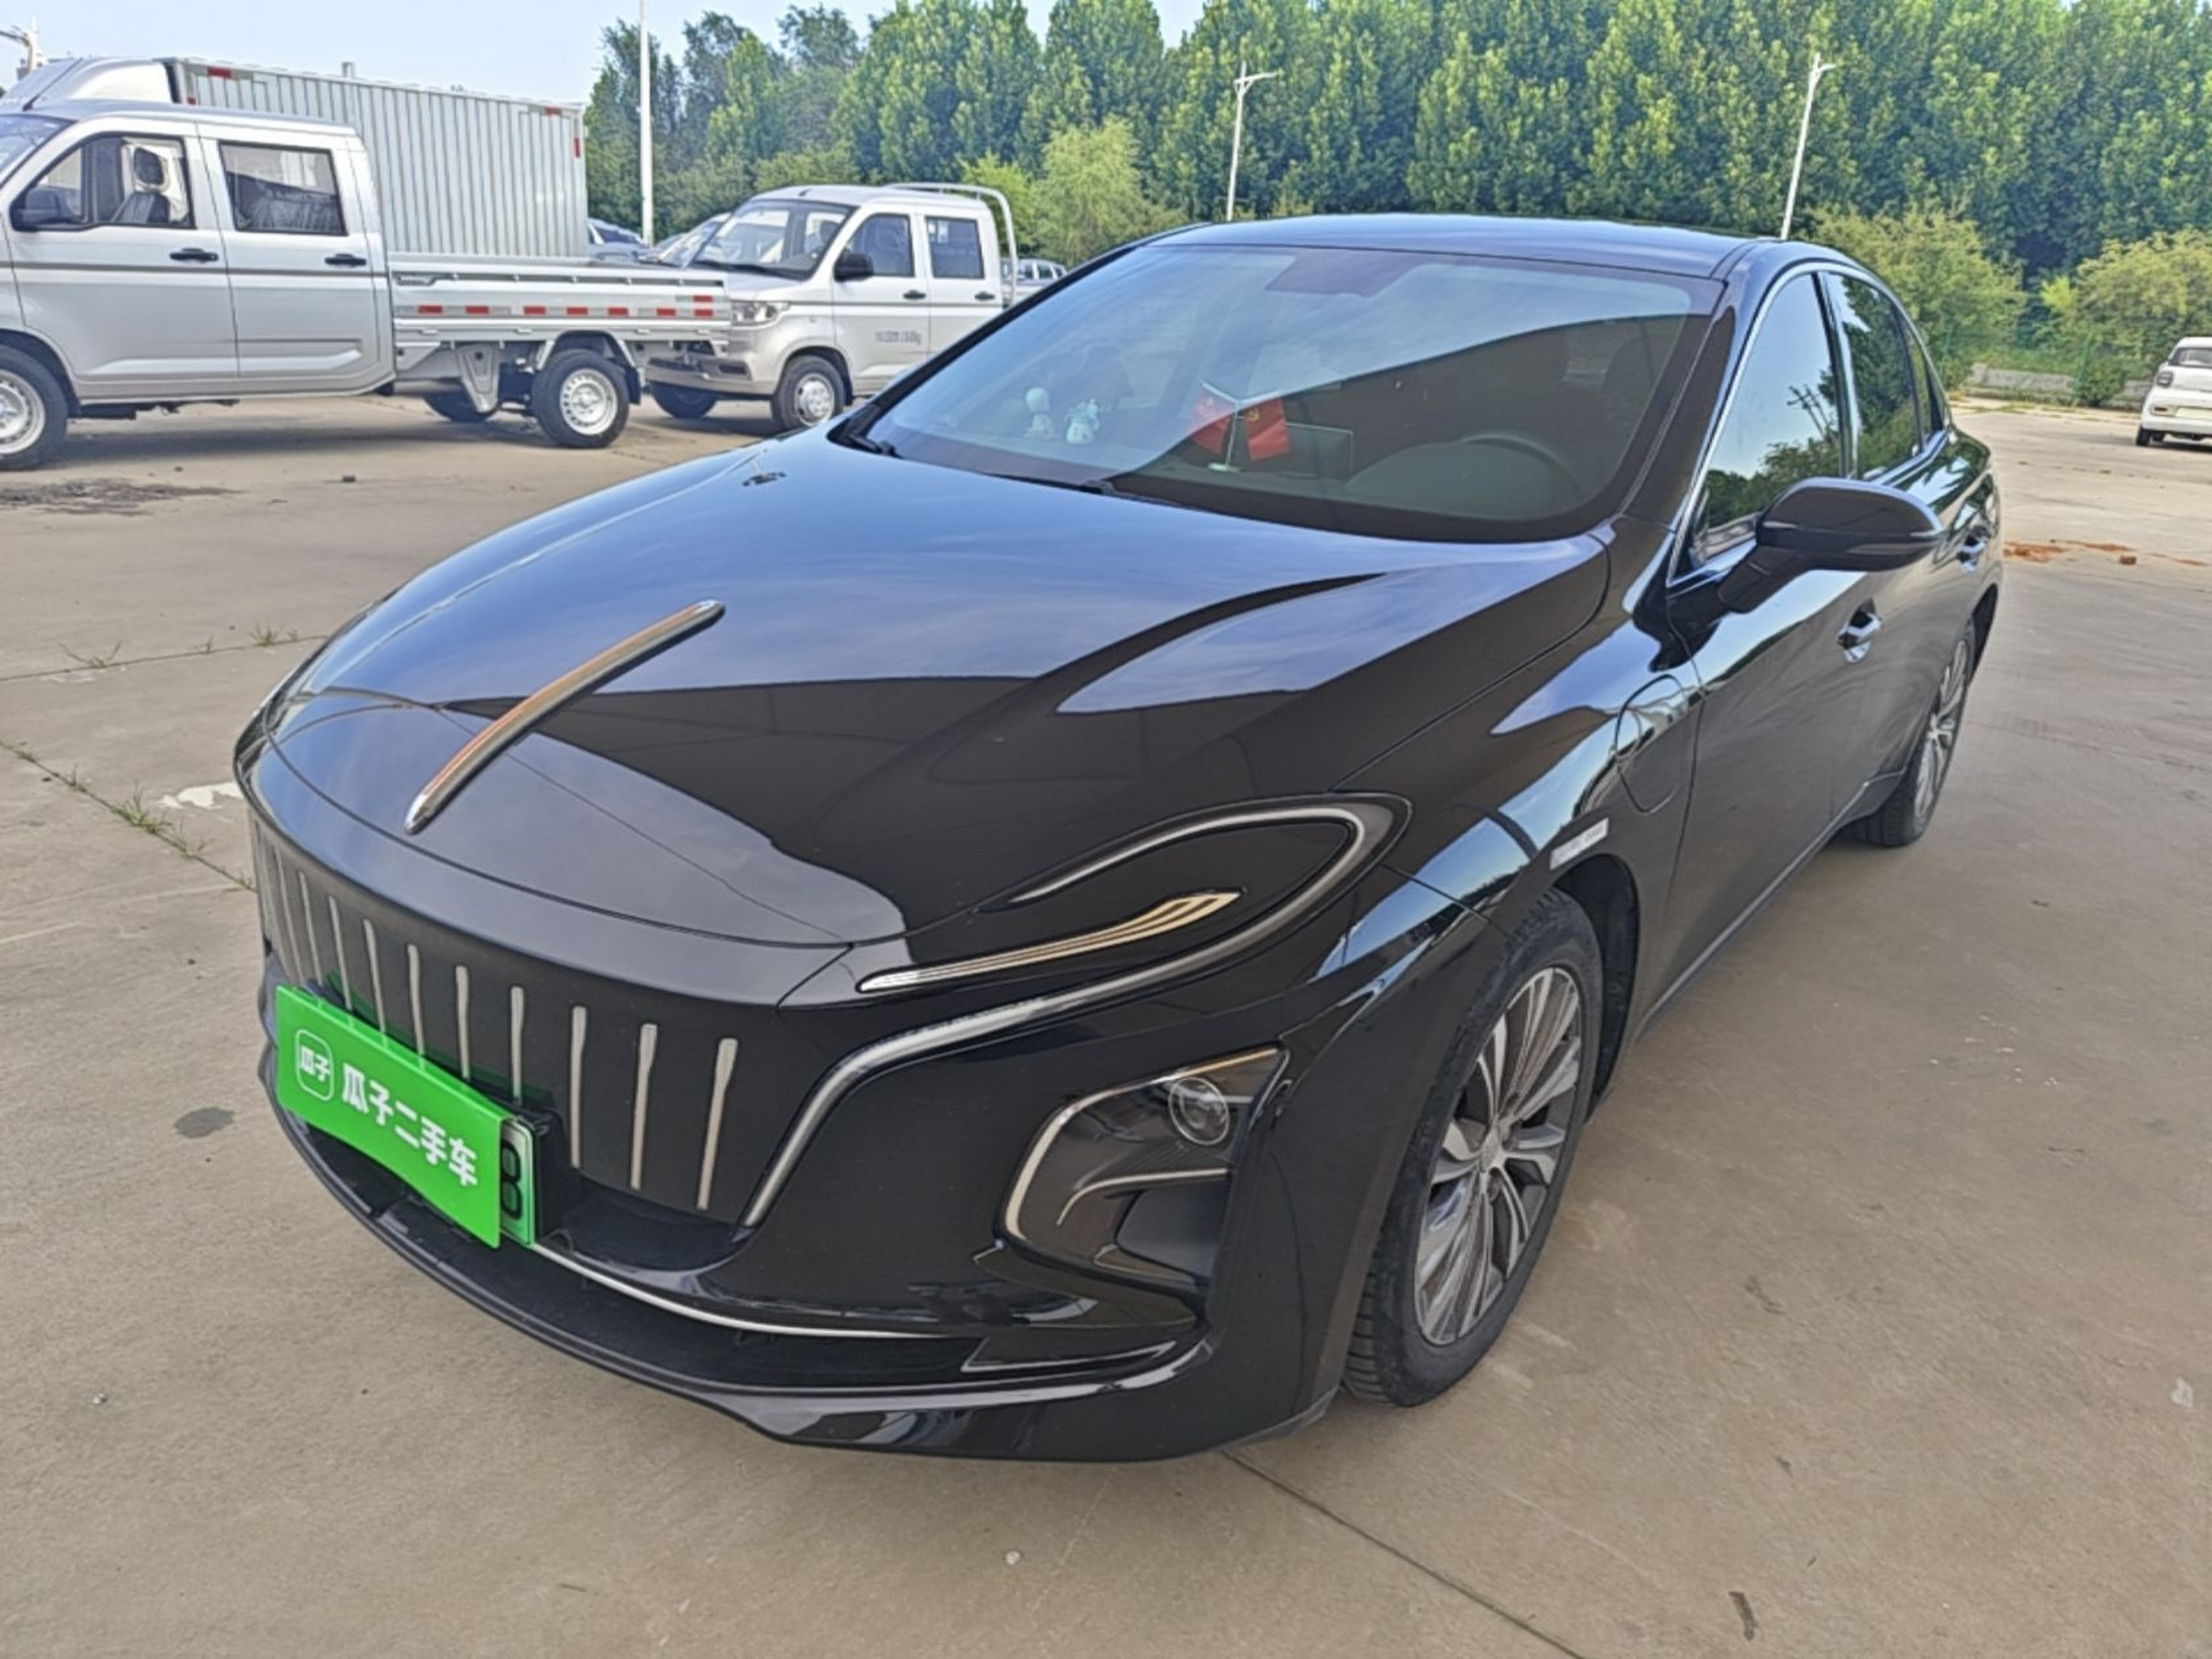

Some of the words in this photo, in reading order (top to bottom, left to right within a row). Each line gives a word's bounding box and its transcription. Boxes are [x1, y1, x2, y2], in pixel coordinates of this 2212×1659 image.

[301, 1046, 331, 1082] 瓜子
[343, 1062, 478, 1187] 瓜子二手车
